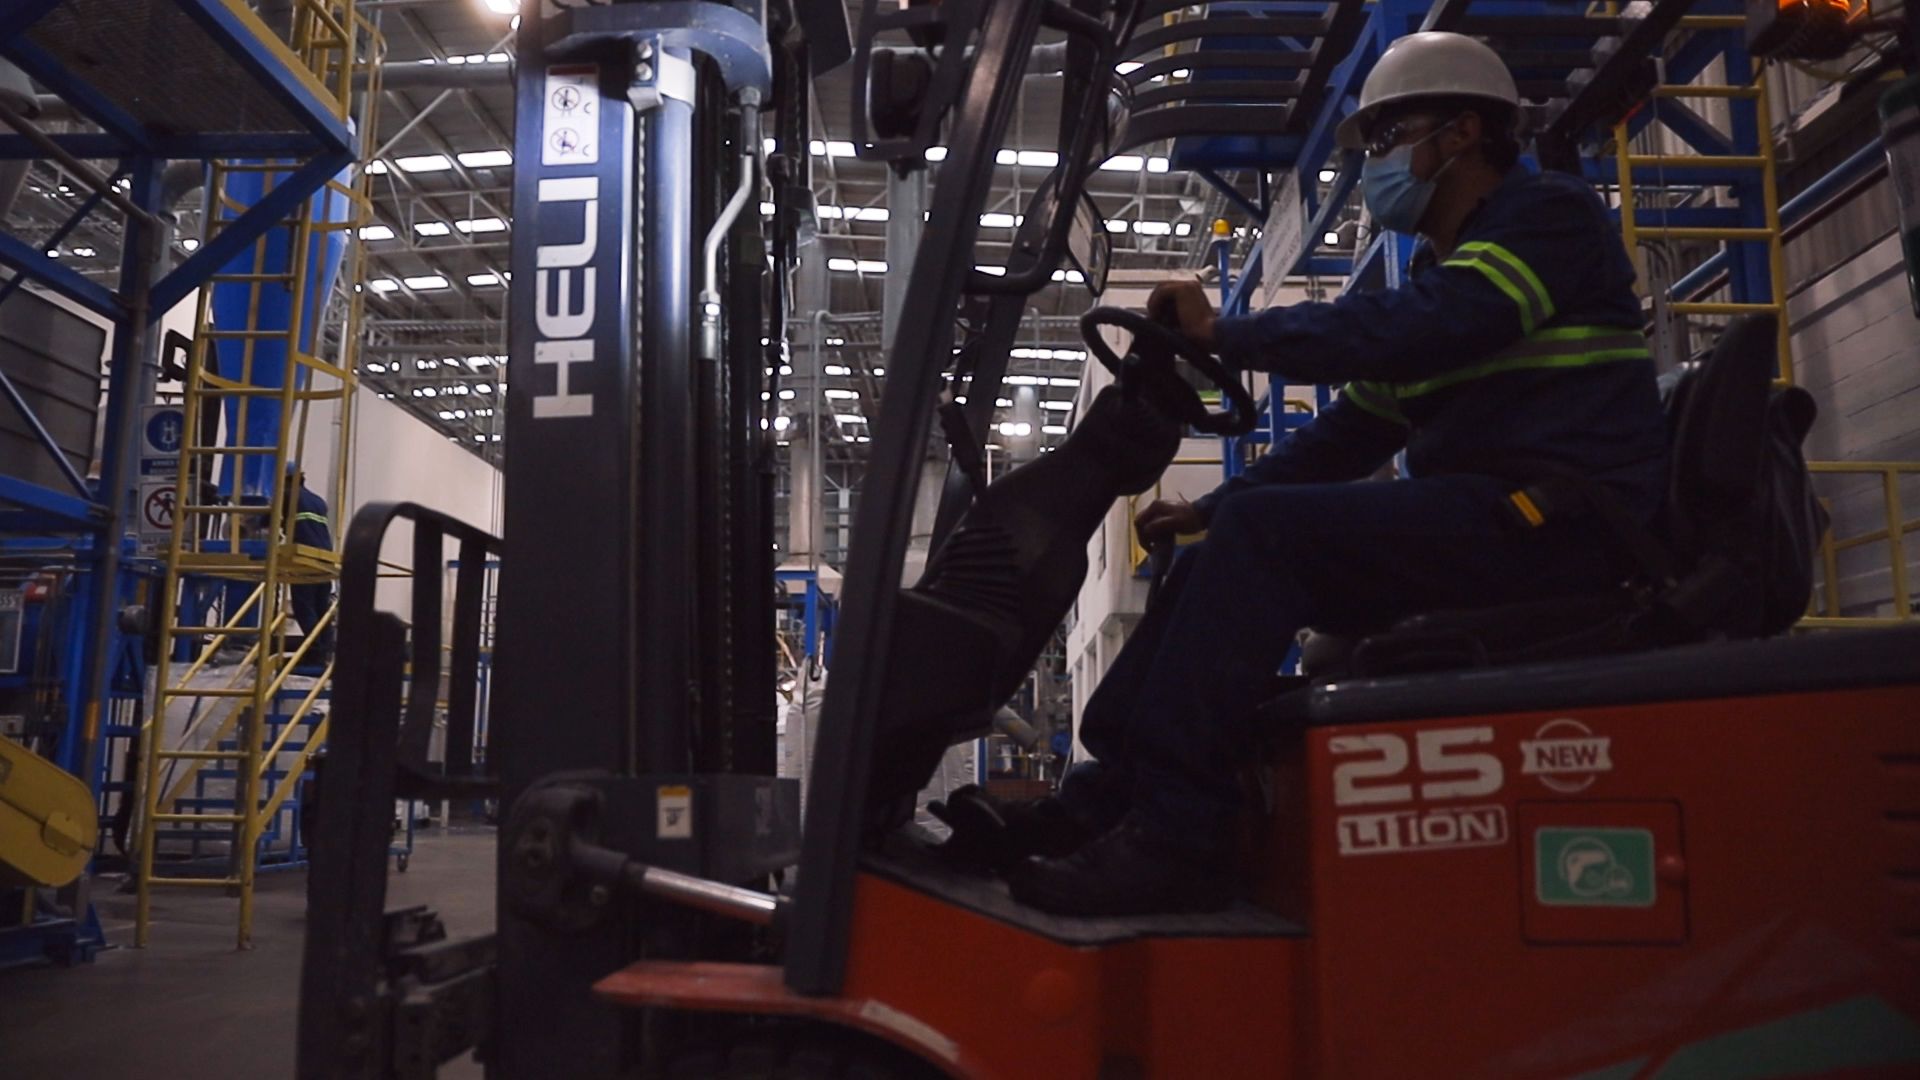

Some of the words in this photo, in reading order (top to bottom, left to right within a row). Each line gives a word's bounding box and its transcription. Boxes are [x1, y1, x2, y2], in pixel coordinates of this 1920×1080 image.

[532, 176, 599, 419] HELI
[1328, 726, 1504, 806] 25
[1536, 744, 1598, 769] NEW
